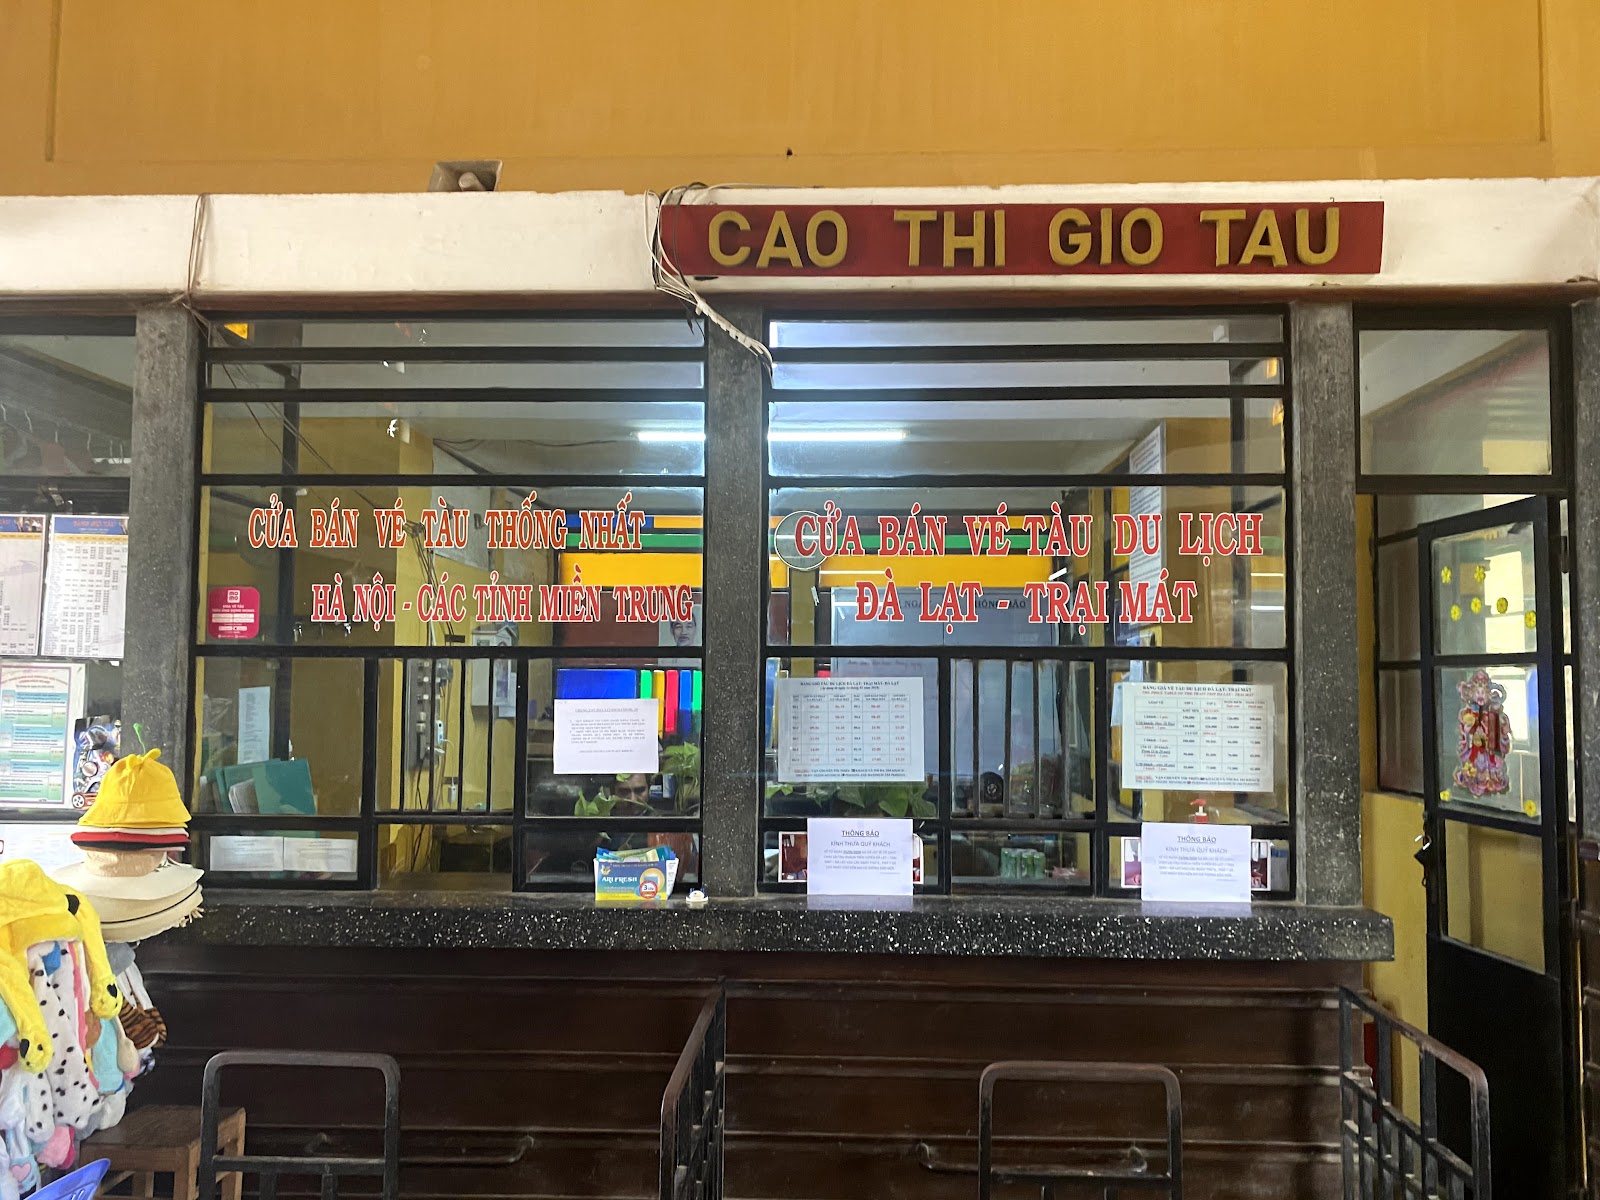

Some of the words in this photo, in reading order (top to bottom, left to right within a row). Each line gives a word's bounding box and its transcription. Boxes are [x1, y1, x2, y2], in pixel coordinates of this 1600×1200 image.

[707, 209, 849, 269] CAO
[893, 210, 1005, 269] THI
[1048, 207, 1163, 267] GIO
[1200, 207, 1340, 267] TAU
[248, 493, 298, 549] CỬA
[310, 497, 359, 549] BÁN
[374, 497, 407, 548] VÉ
[421, 496, 468, 549] TÀU
[484, 490, 567, 550] THỐNG
[579, 492, 646, 549] NHẤT
[794, 500, 865, 557] CỬA
[877, 502, 948, 557] BÁN
[963, 502, 1012, 557] VÉ
[1022, 501, 1094, 558] TÀU
[1113, 512, 1162, 557] DU
[1179, 512, 1264, 567] LỊCH
[311, 573, 347, 622] HÀ
[353, 572, 396, 630] NỘI
[417, 572, 466, 623] CÁC
[473, 570, 533, 622] TỈNH
[538, 564, 601, 623] MIỀN
[612, 584, 694, 623] TRUNG
[855, 568, 904, 622] ĐÀ
[918, 581, 984, 635] LẠT
[1023, 581, 1109, 636] TRẠI
[1119, 568, 1198, 624] MÁT
[842, 829, 864, 837] THÔNG
